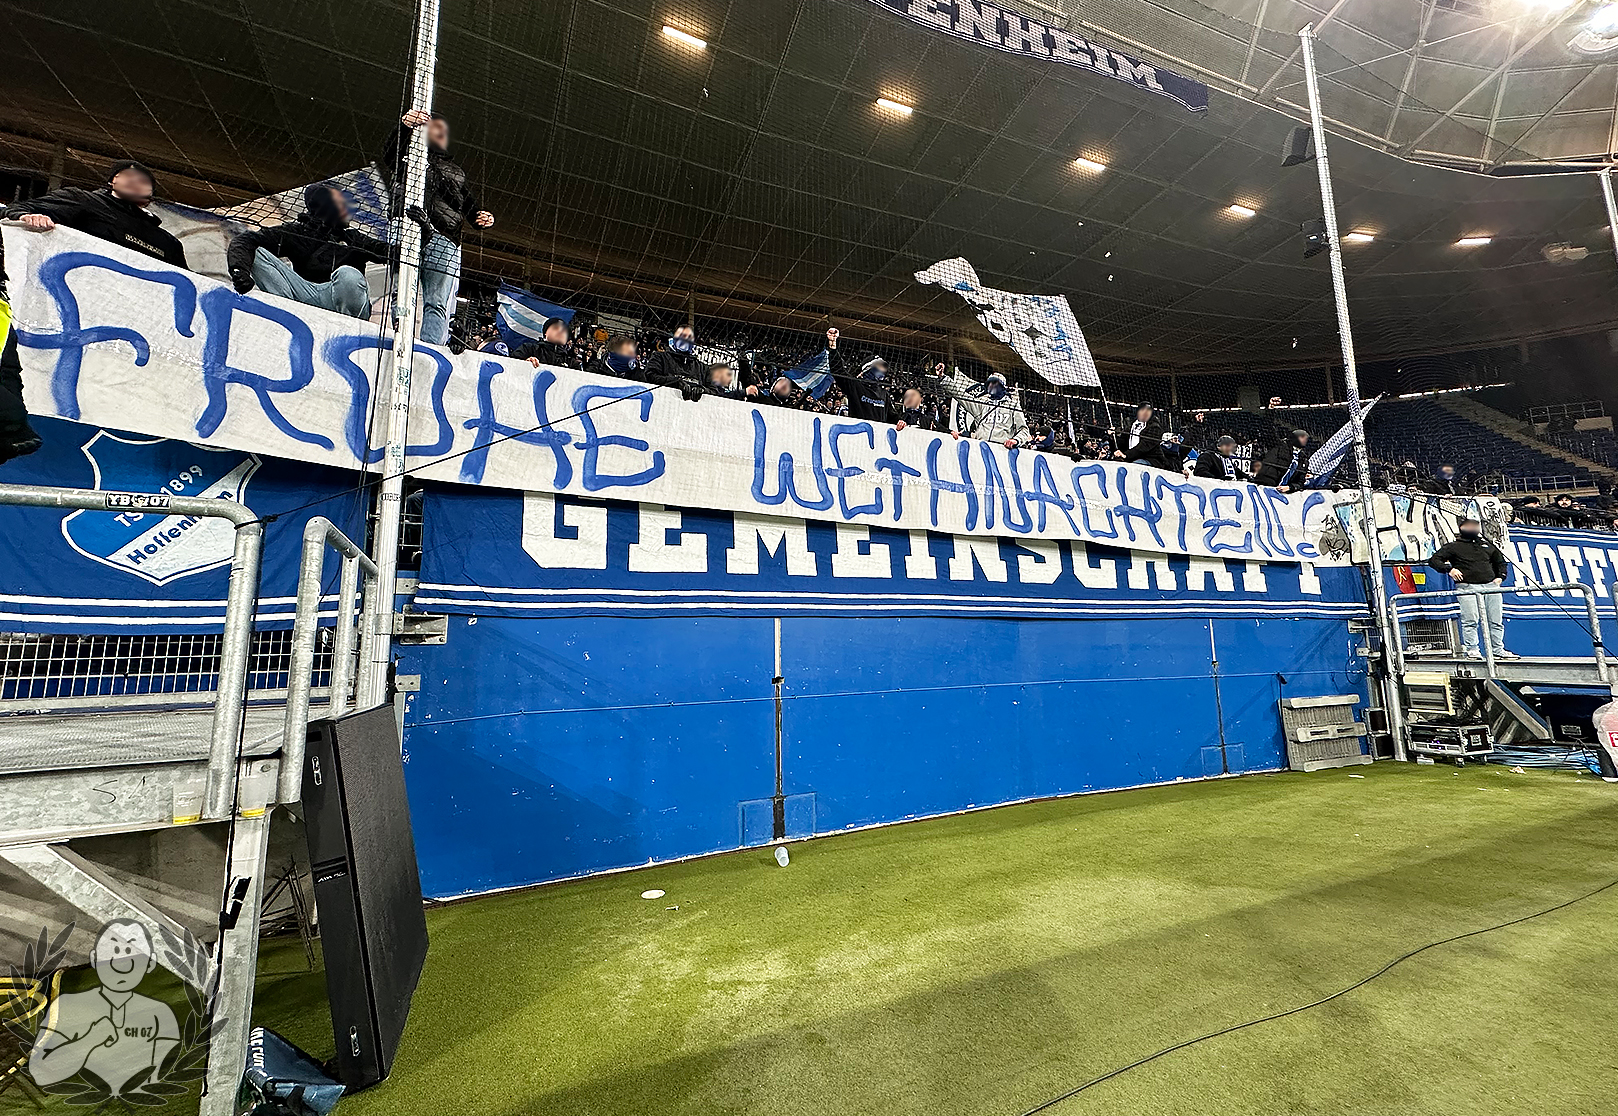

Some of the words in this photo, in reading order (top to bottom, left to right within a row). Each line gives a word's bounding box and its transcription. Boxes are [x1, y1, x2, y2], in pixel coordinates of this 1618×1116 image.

[17, 251, 666, 491] FROHE
[150, 496, 169, 506] 07
[1502, 541, 1618, 597] HOFF
